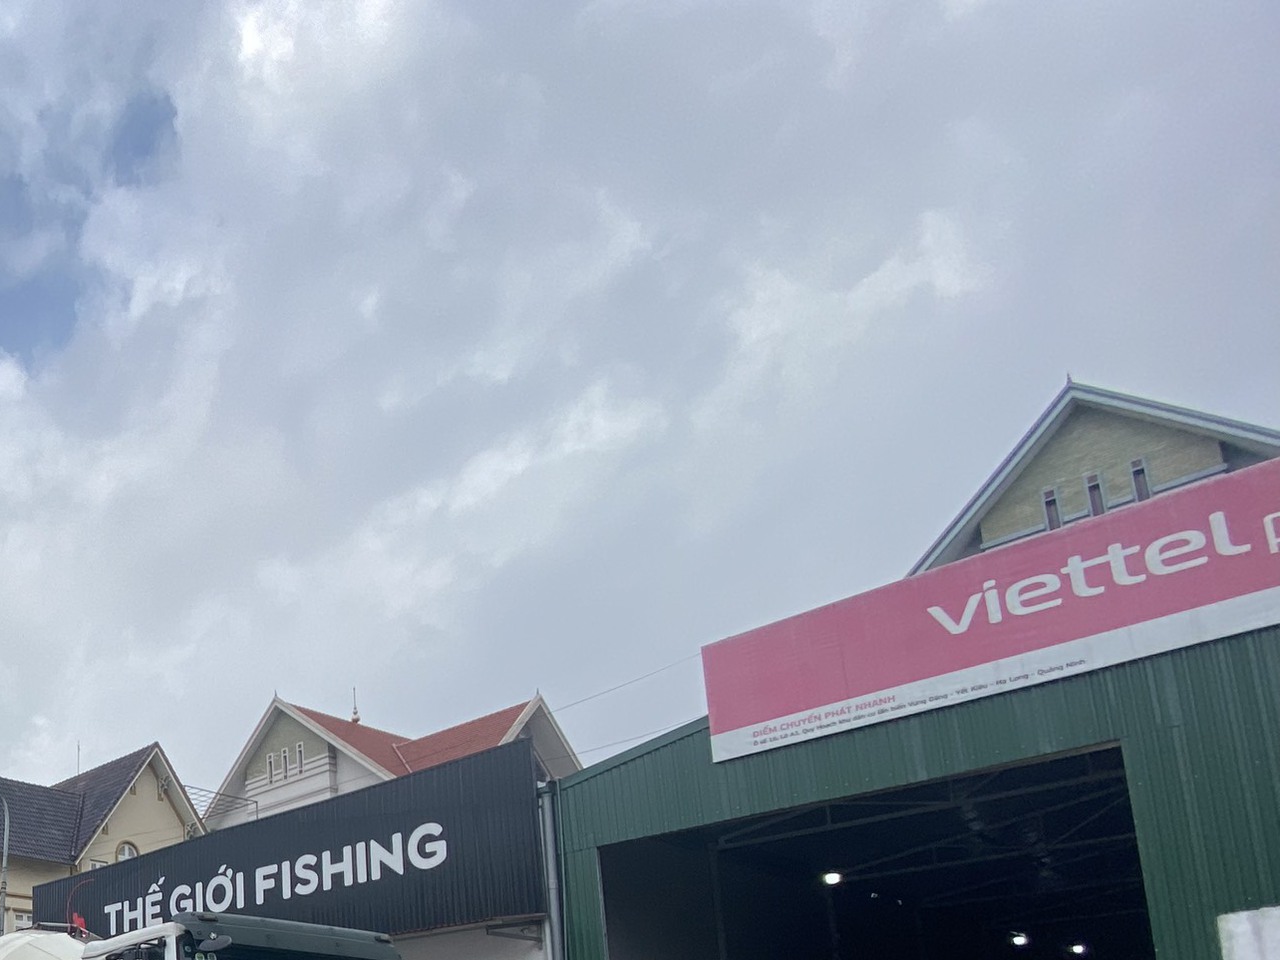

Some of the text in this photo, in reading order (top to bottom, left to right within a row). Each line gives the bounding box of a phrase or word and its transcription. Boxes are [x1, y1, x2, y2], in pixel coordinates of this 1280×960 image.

[927, 511, 1251, 635] viettel
[855, 695, 896, 711] NHANH
[104, 822, 447, 936] THẾ GIỚI FISHING
